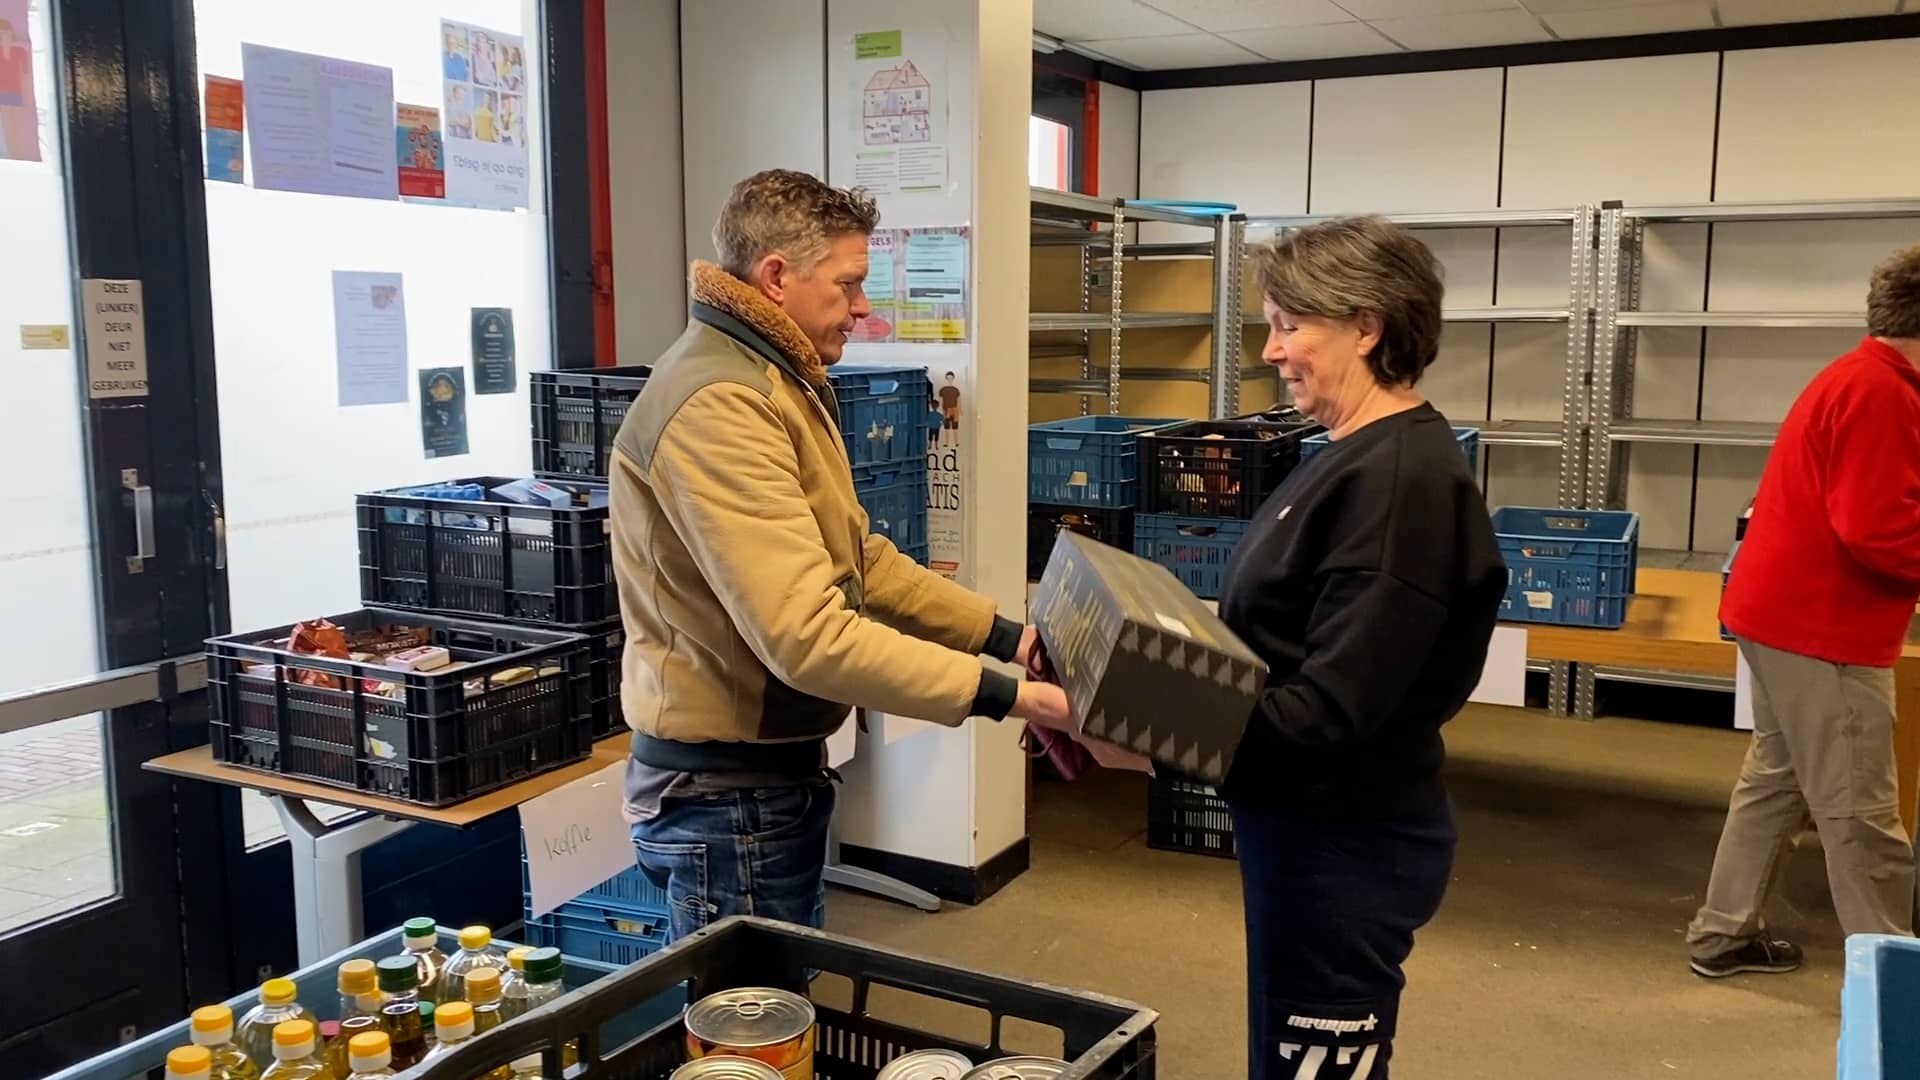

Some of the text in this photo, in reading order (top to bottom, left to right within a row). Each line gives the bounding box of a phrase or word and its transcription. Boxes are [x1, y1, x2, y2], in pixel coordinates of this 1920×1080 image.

[870, 236, 891, 247] GELS
[103, 283, 129, 294] DEZE
[96, 302, 139, 315] (LINKER)
[105, 321, 132, 332] DEUR
[108, 341, 131, 351] NIET
[106, 360, 135, 371] MEER
[931, 472, 960, 482] ACH
